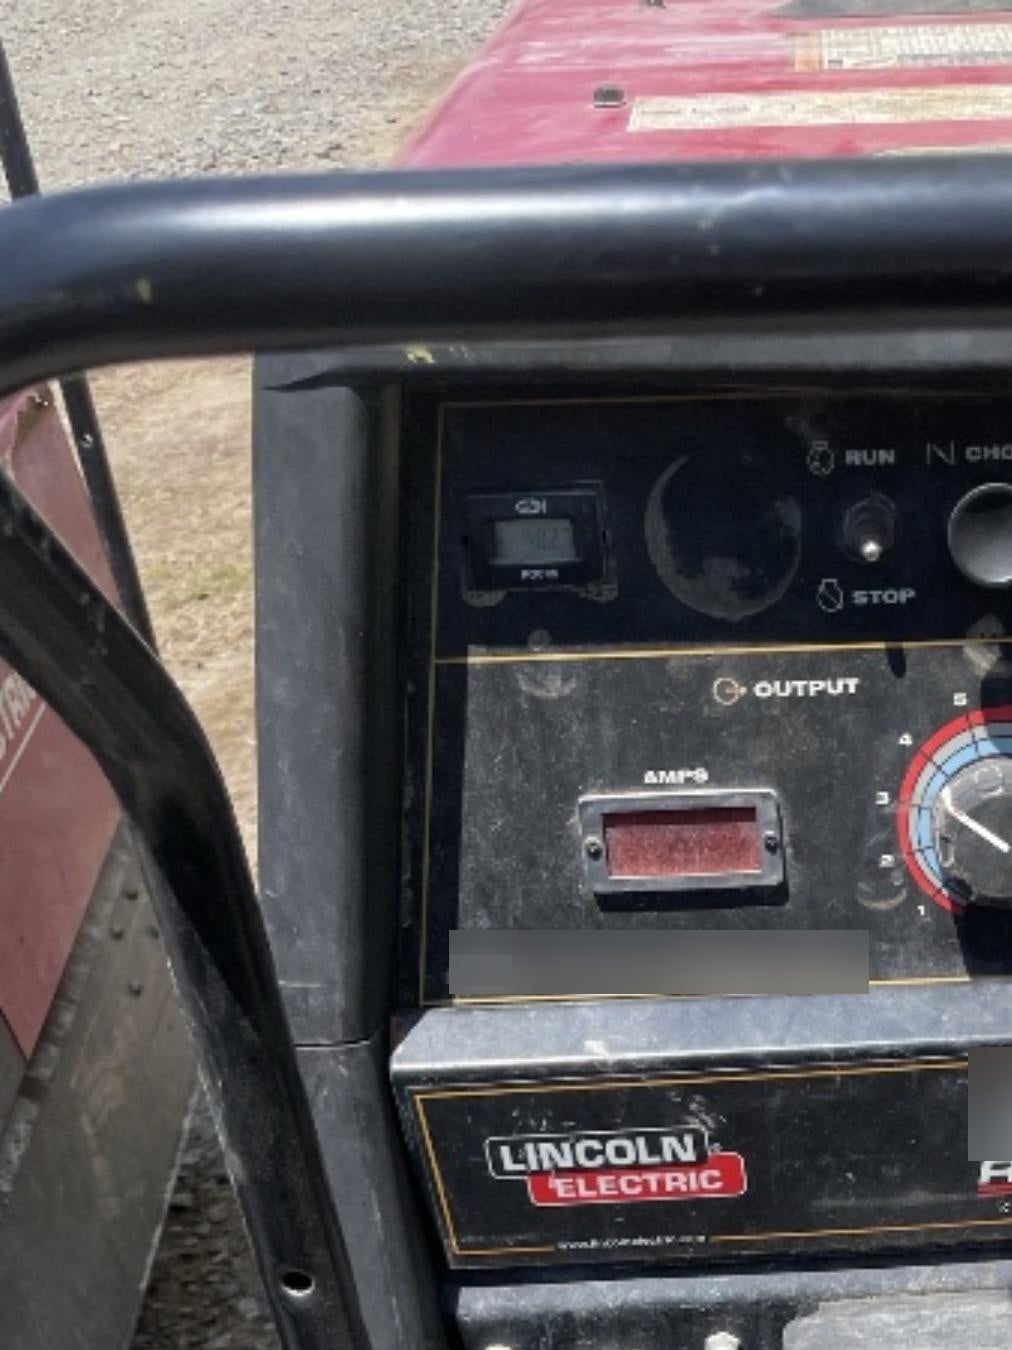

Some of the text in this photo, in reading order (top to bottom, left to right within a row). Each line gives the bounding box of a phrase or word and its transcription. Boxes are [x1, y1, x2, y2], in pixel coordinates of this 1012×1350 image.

[845, 449, 895, 466] RUN
[852, 587, 916, 605] STOP
[753, 678, 859, 698] OUTPUT
[953, 693, 968, 705] 5
[899, 734, 913, 745] 4
[644, 768, 708, 784] AMPS
[879, 854, 894, 867] 2
[917, 905, 926, 916] 1
[500, 1135, 695, 1171] LINCOLN
[549, 1169, 724, 1198] ELECTRIC
